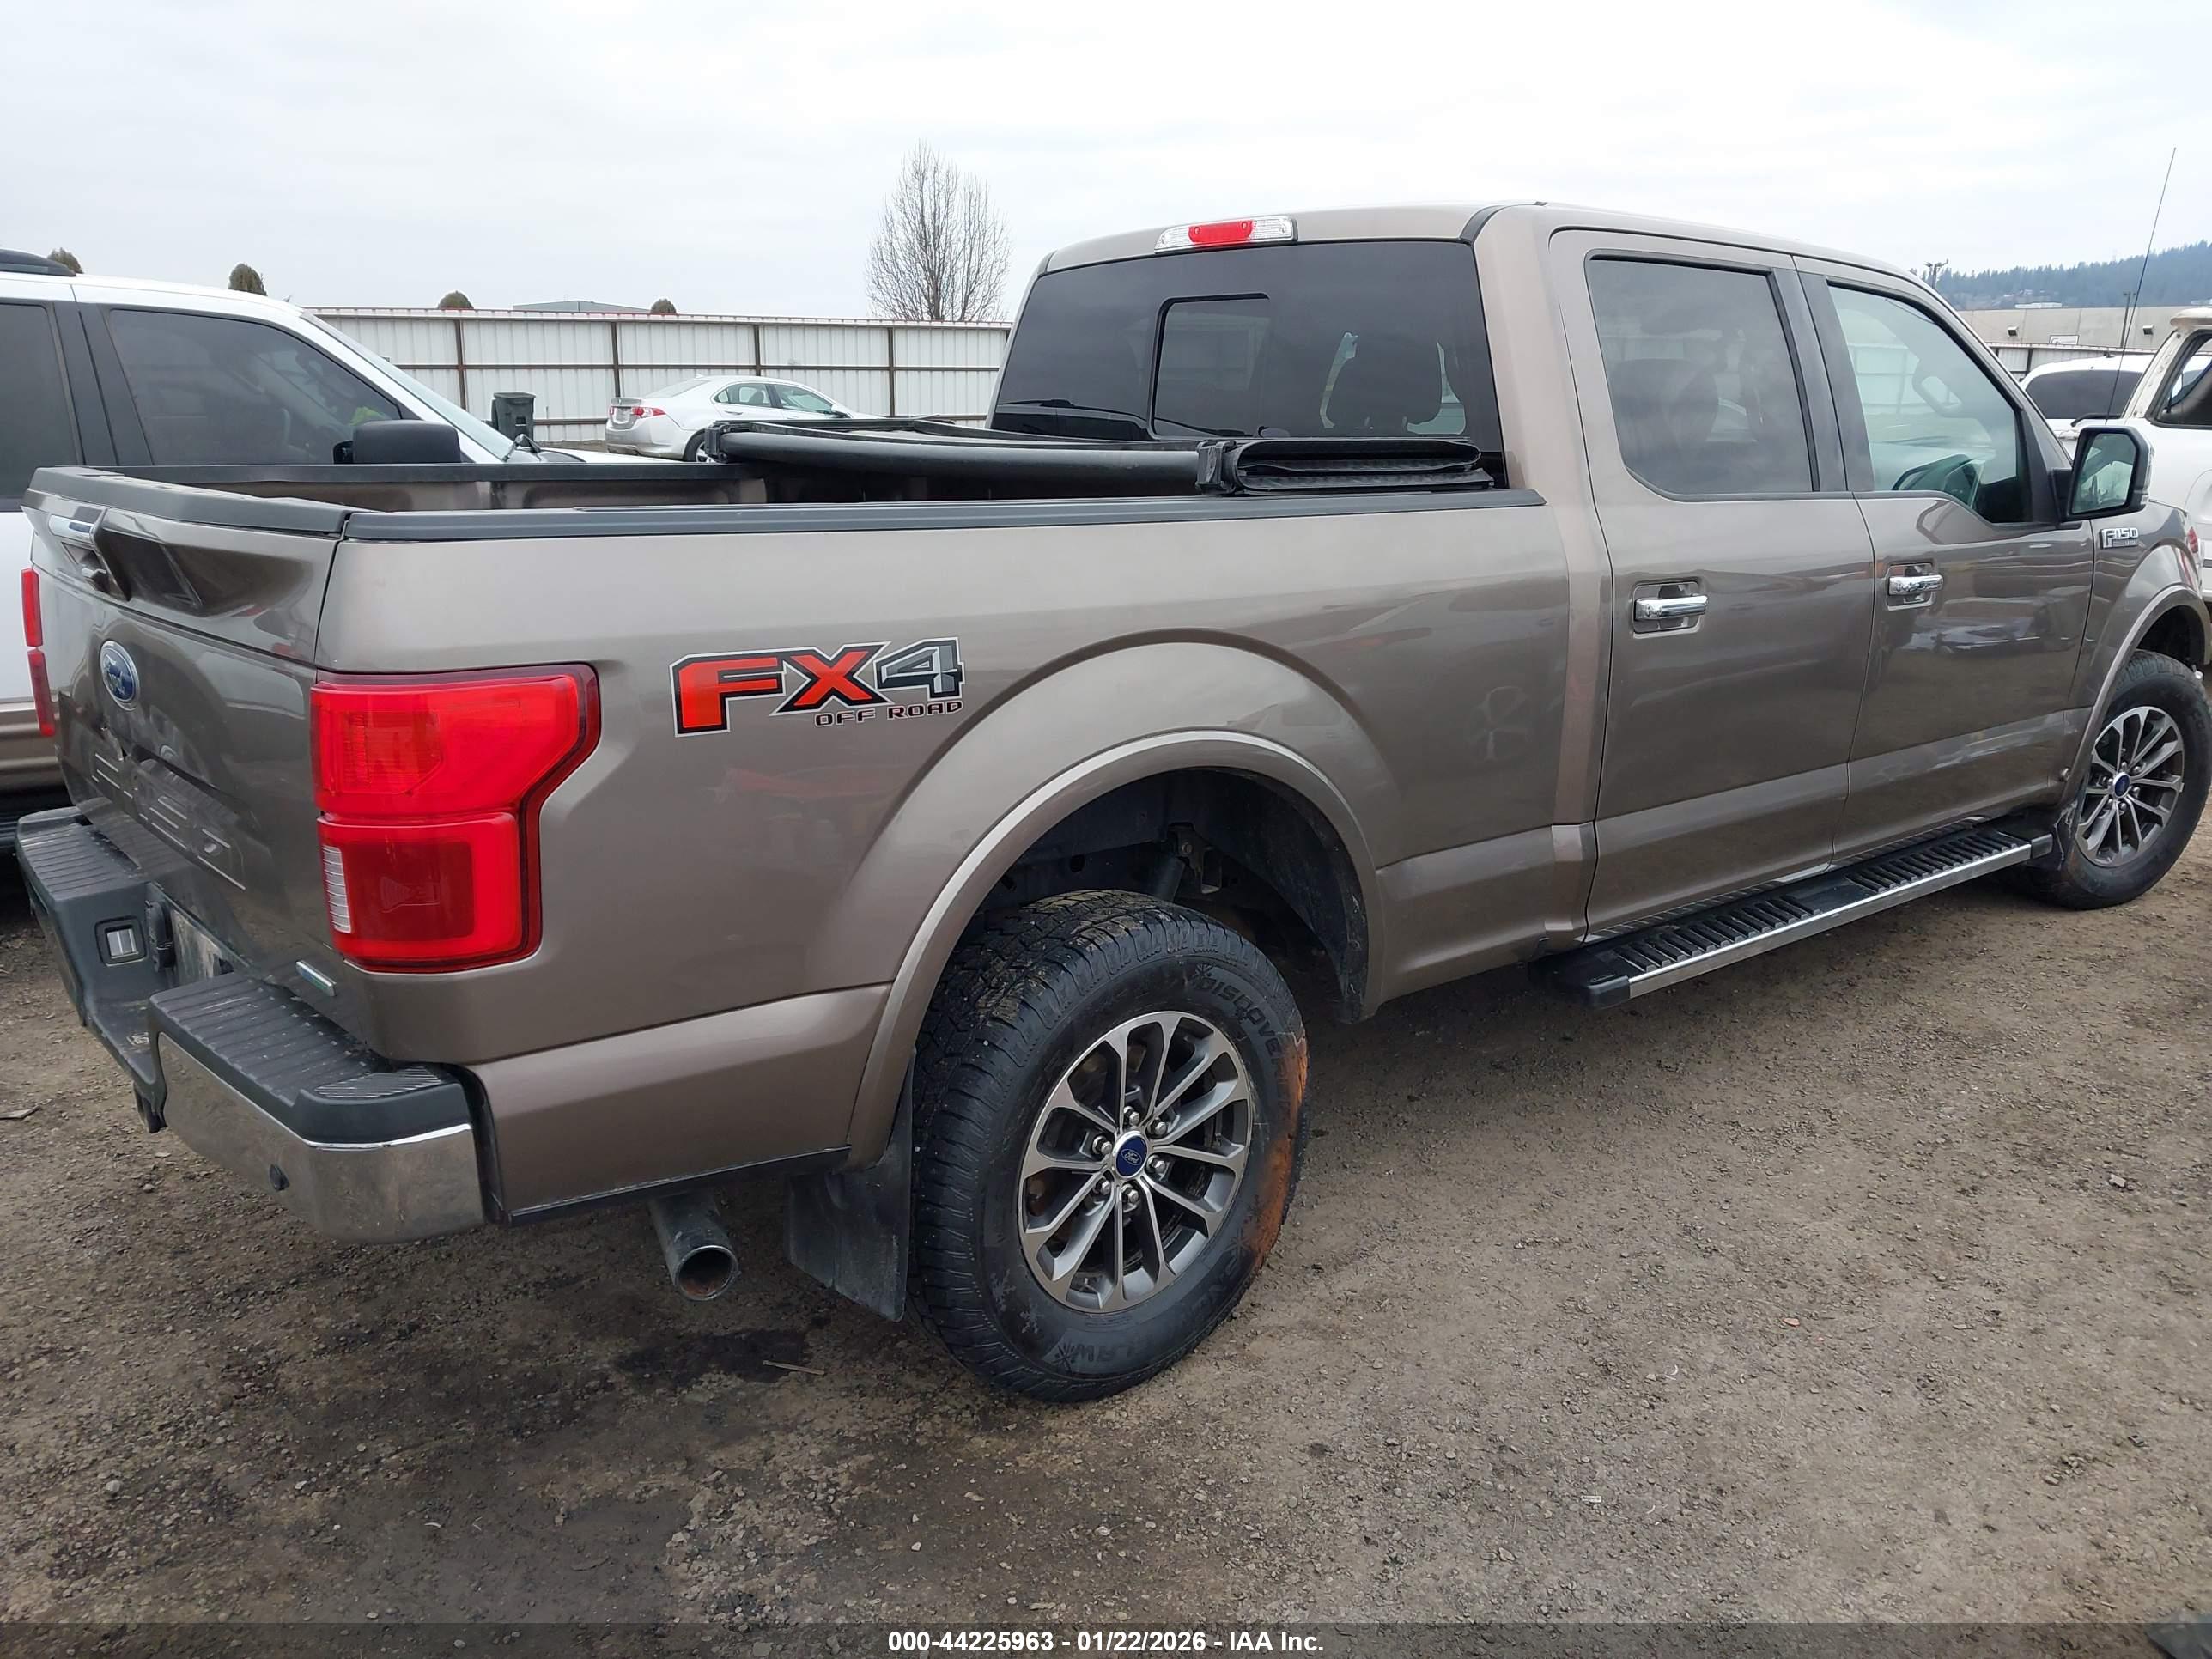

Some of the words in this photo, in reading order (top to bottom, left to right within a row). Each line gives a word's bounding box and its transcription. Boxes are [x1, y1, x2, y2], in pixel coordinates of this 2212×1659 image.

[669, 637, 965, 737] FX4
[815, 708, 876, 727] OFF
[886, 700, 963, 720] ROAD
